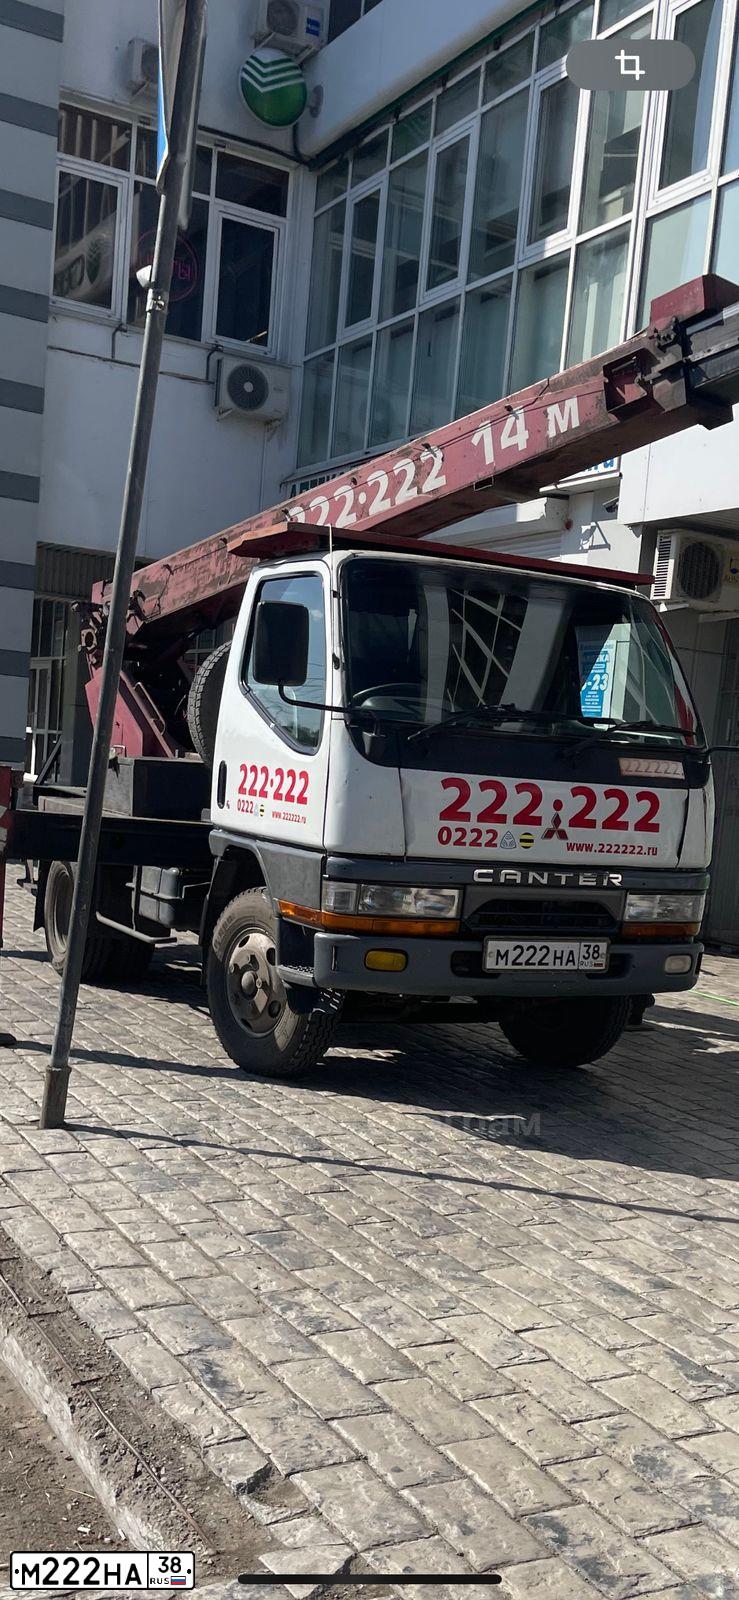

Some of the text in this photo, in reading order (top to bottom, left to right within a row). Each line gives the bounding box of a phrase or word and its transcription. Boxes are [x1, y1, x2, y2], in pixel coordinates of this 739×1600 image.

[471, 406, 529, 466] 14
[236, 798, 254, 814] 0222
[437, 826, 499, 848] 0222
[566, 842, 658, 856] www.222222.ru
[473, 868, 623, 887] CANTER
[495, 944, 601, 967] М222НА 38
[580, 960, 594, 968] RUS
